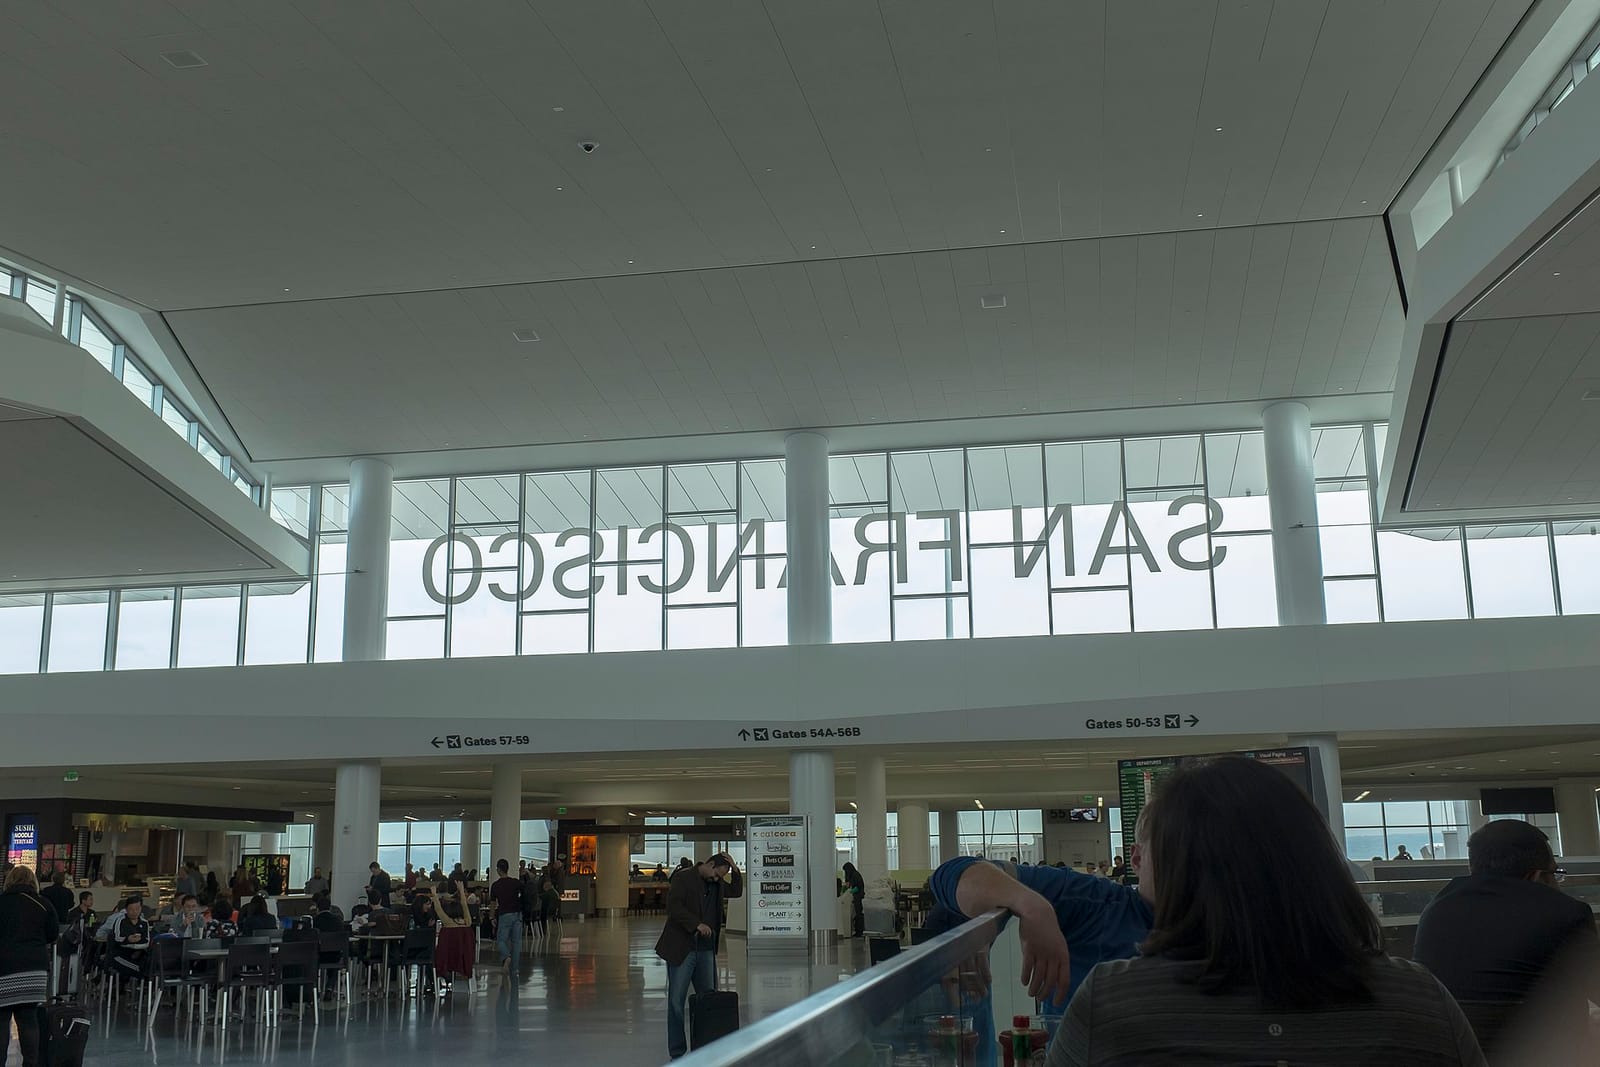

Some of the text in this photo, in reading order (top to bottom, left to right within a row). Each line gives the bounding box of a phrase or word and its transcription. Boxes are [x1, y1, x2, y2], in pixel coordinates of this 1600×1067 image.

[1085, 717, 1161, 729] Gates 50-53
[772, 727, 861, 739] Gates 54A-56B
[463, 735, 530, 746] Gates 57-59
[14, 824, 34, 832] SUSHI
